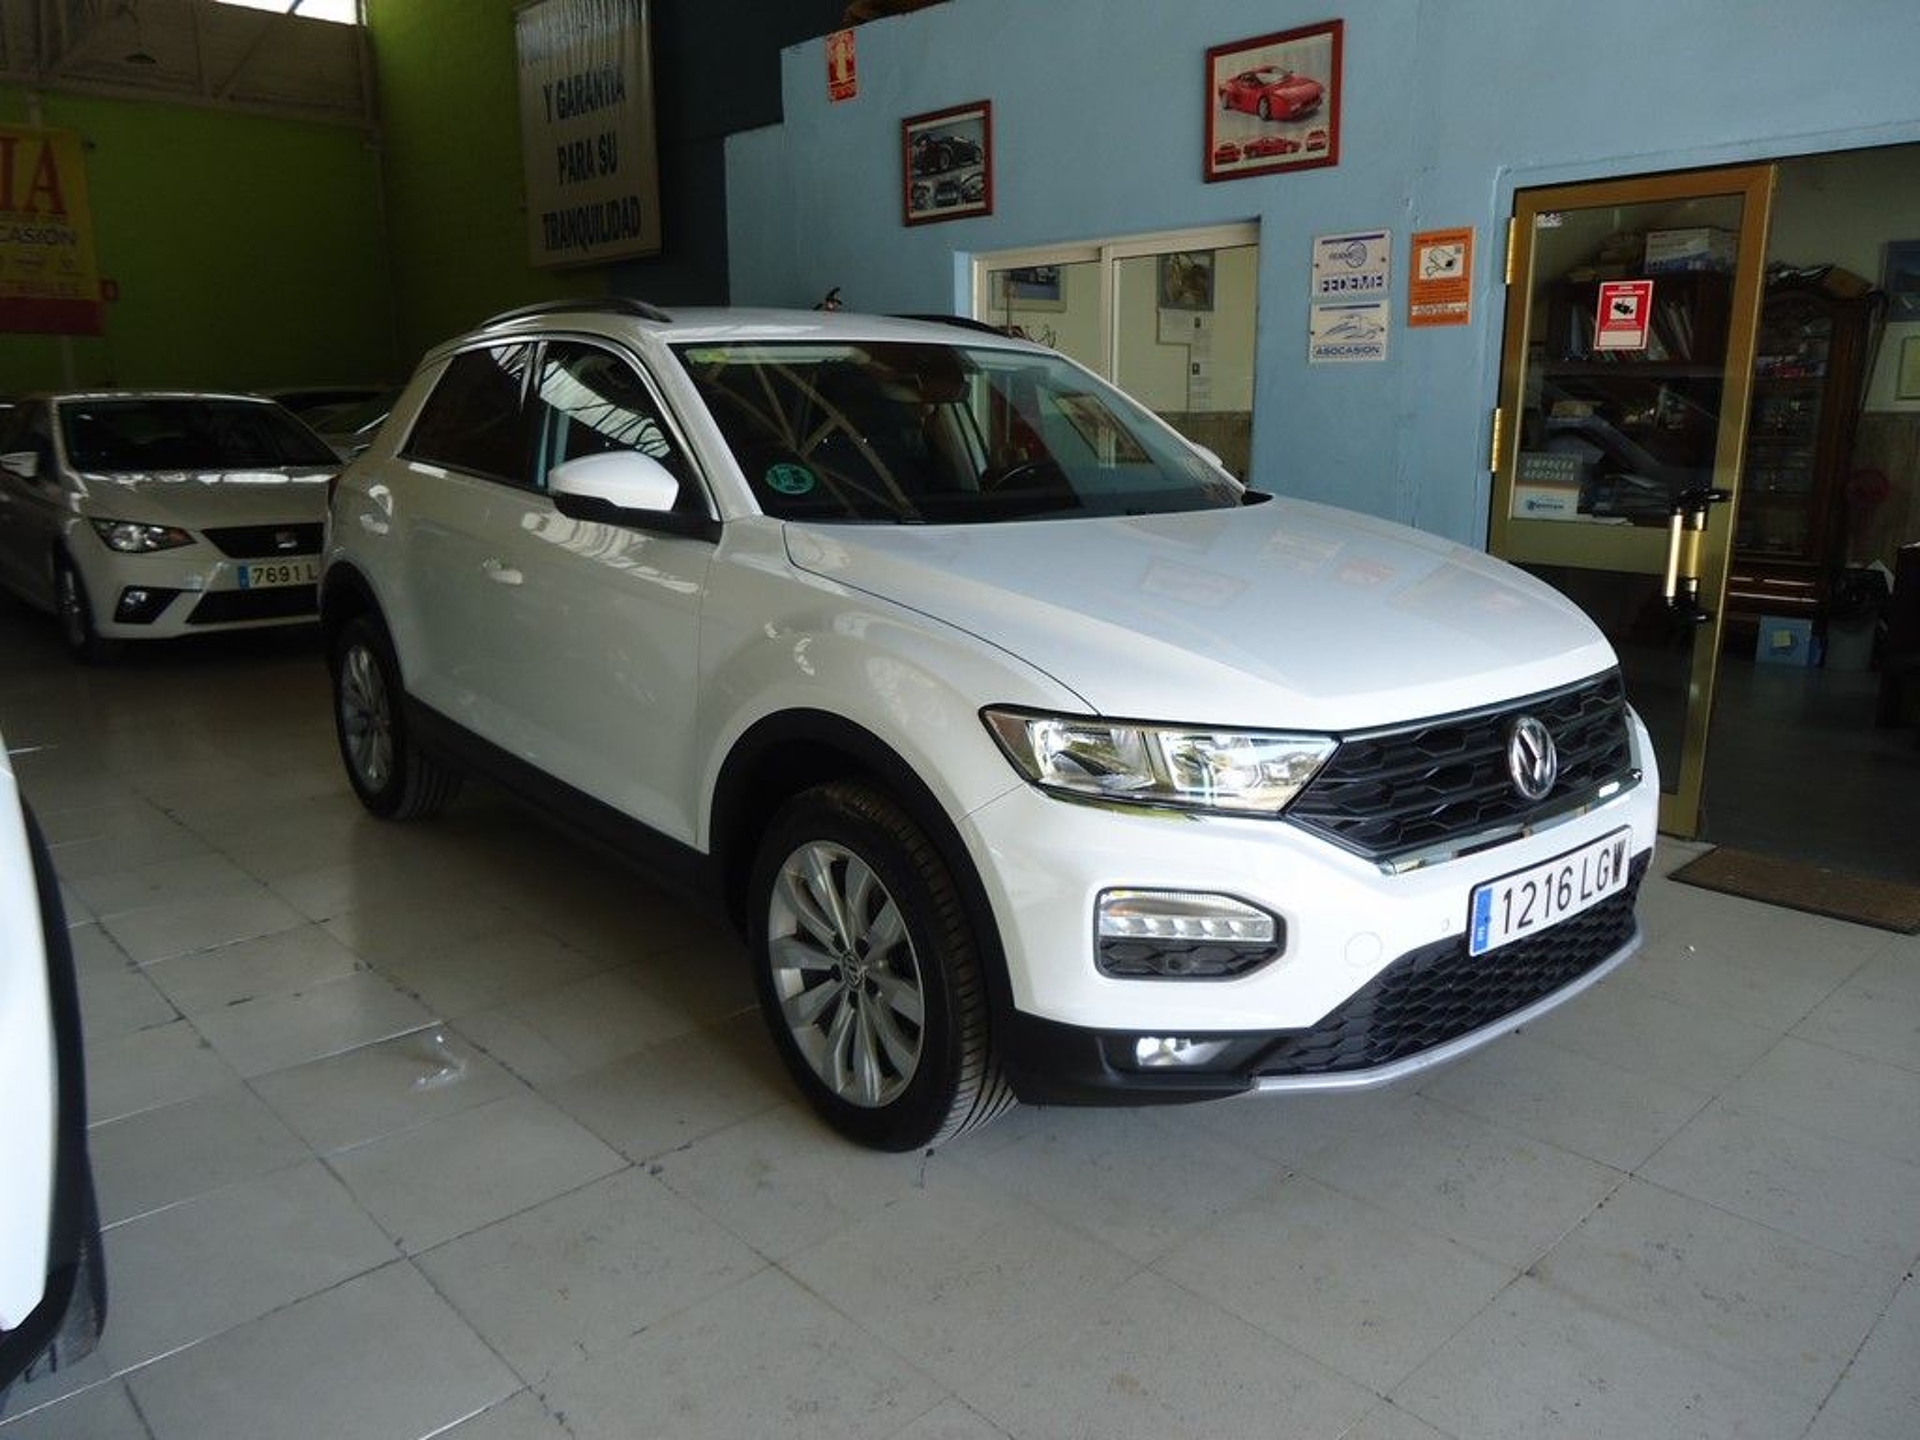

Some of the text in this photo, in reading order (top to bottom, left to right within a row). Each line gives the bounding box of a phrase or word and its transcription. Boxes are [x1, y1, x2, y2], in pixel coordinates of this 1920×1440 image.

[543, 79, 553, 124] Y
[557, 132, 618, 186] PARA SU
[542, 196, 641, 253] TRANQUILIDAD
[1316, 344, 1380, 357] ASOCASION
[252, 565, 301, 586] 7691
[1502, 838, 1627, 935] 1216 LGW
